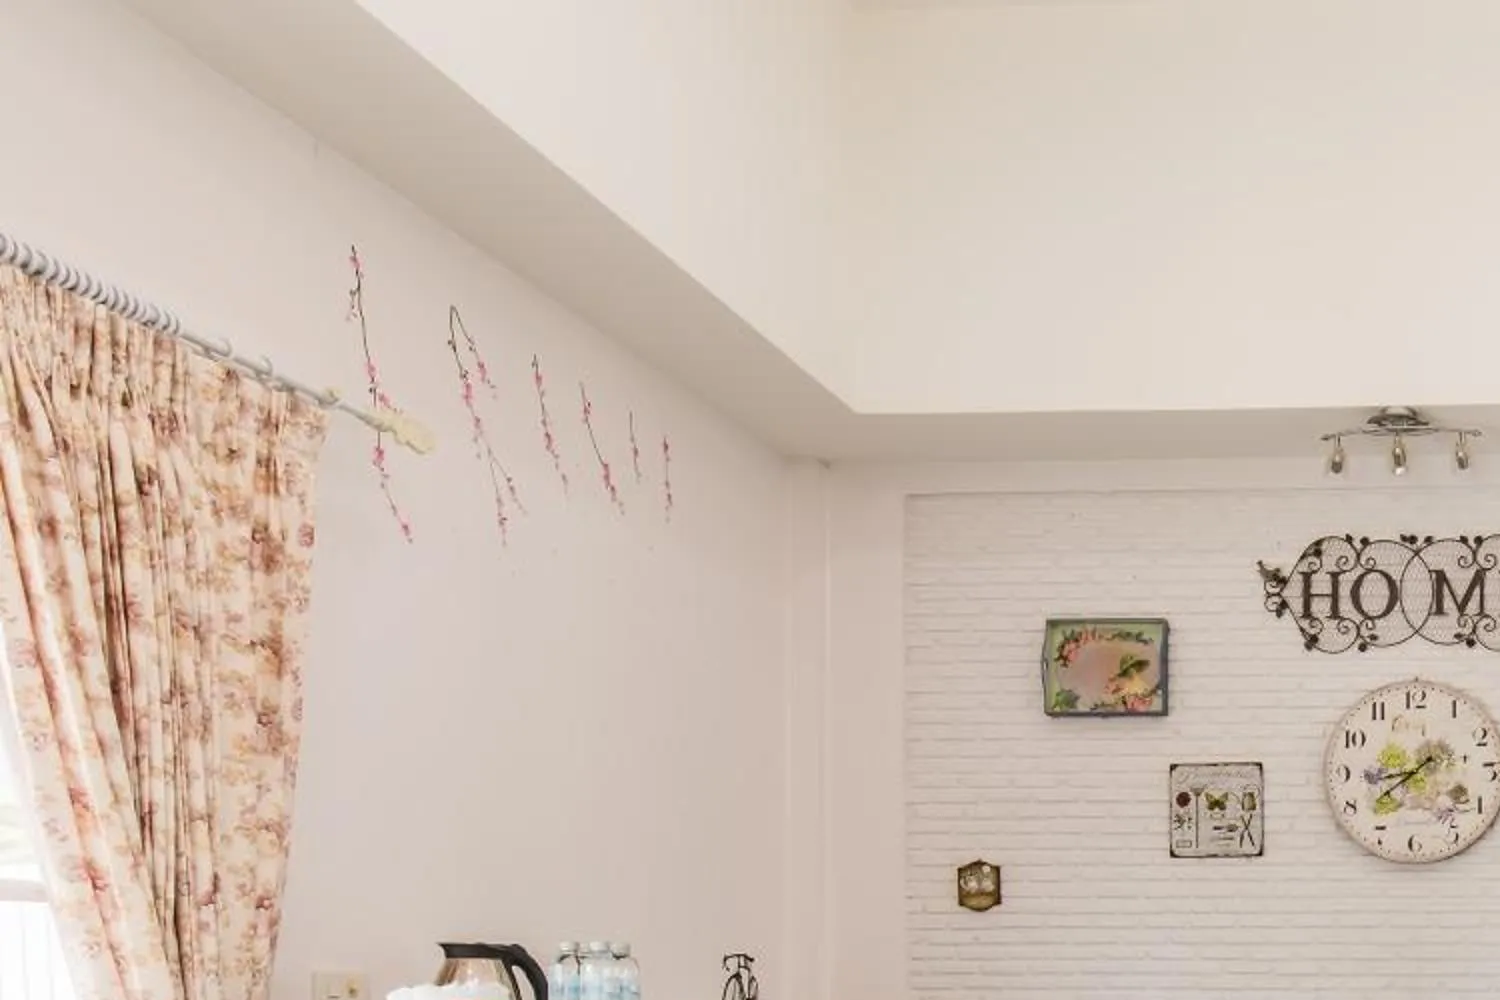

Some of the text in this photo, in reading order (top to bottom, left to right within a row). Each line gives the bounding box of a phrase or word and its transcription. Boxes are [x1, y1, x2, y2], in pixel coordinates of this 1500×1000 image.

[1405, 690, 1427, 709] 12
[1452, 699, 1457, 718] 1
[1372, 702, 1385, 720] 11
[1345, 730, 1366, 748] 10
[1472, 727, 1488, 747] 2
[1336, 765, 1351, 783] 9
[1343, 800, 1357, 816] 8
[1407, 834, 1423, 852] 6
